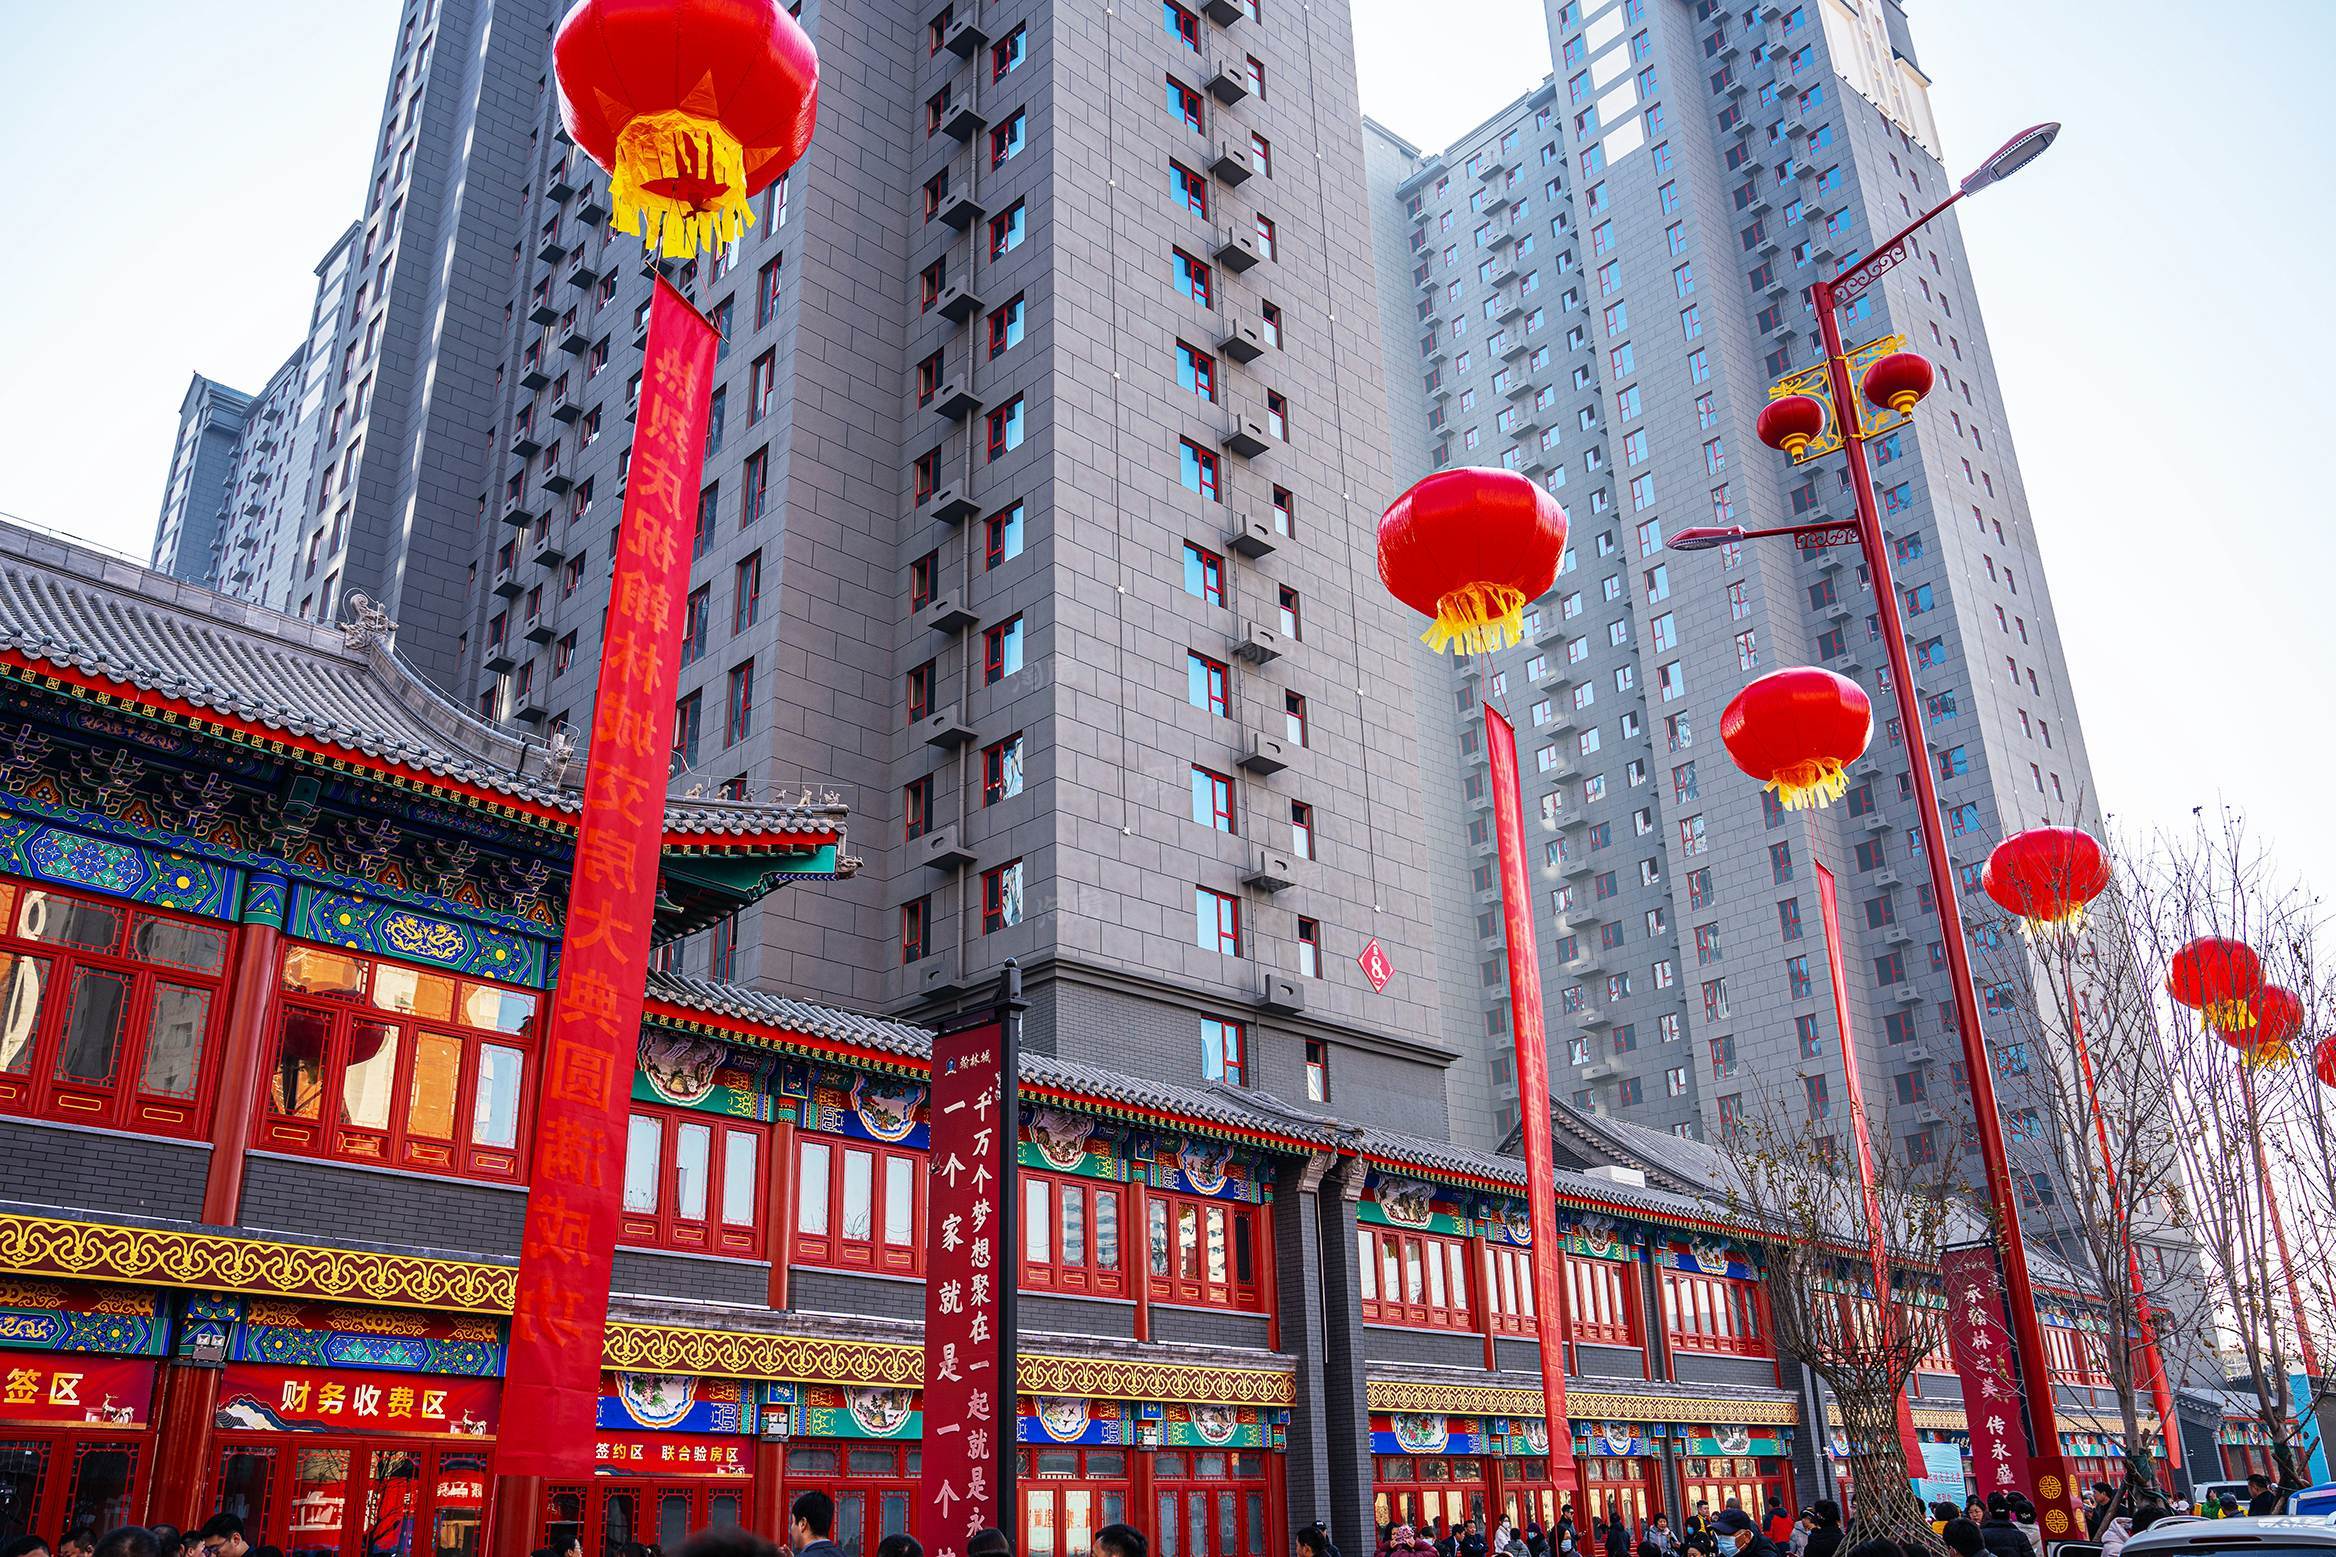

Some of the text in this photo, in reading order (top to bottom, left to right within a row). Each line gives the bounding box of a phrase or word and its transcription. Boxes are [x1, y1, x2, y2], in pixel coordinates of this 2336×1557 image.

[4, 1368, 84, 1406] 签区
[280, 1380, 448, 1419] 财务收费区
[595, 1442, 738, 1462] 签约区 联合验房区
[1986, 1415, 2015, 1498] 传永盛
